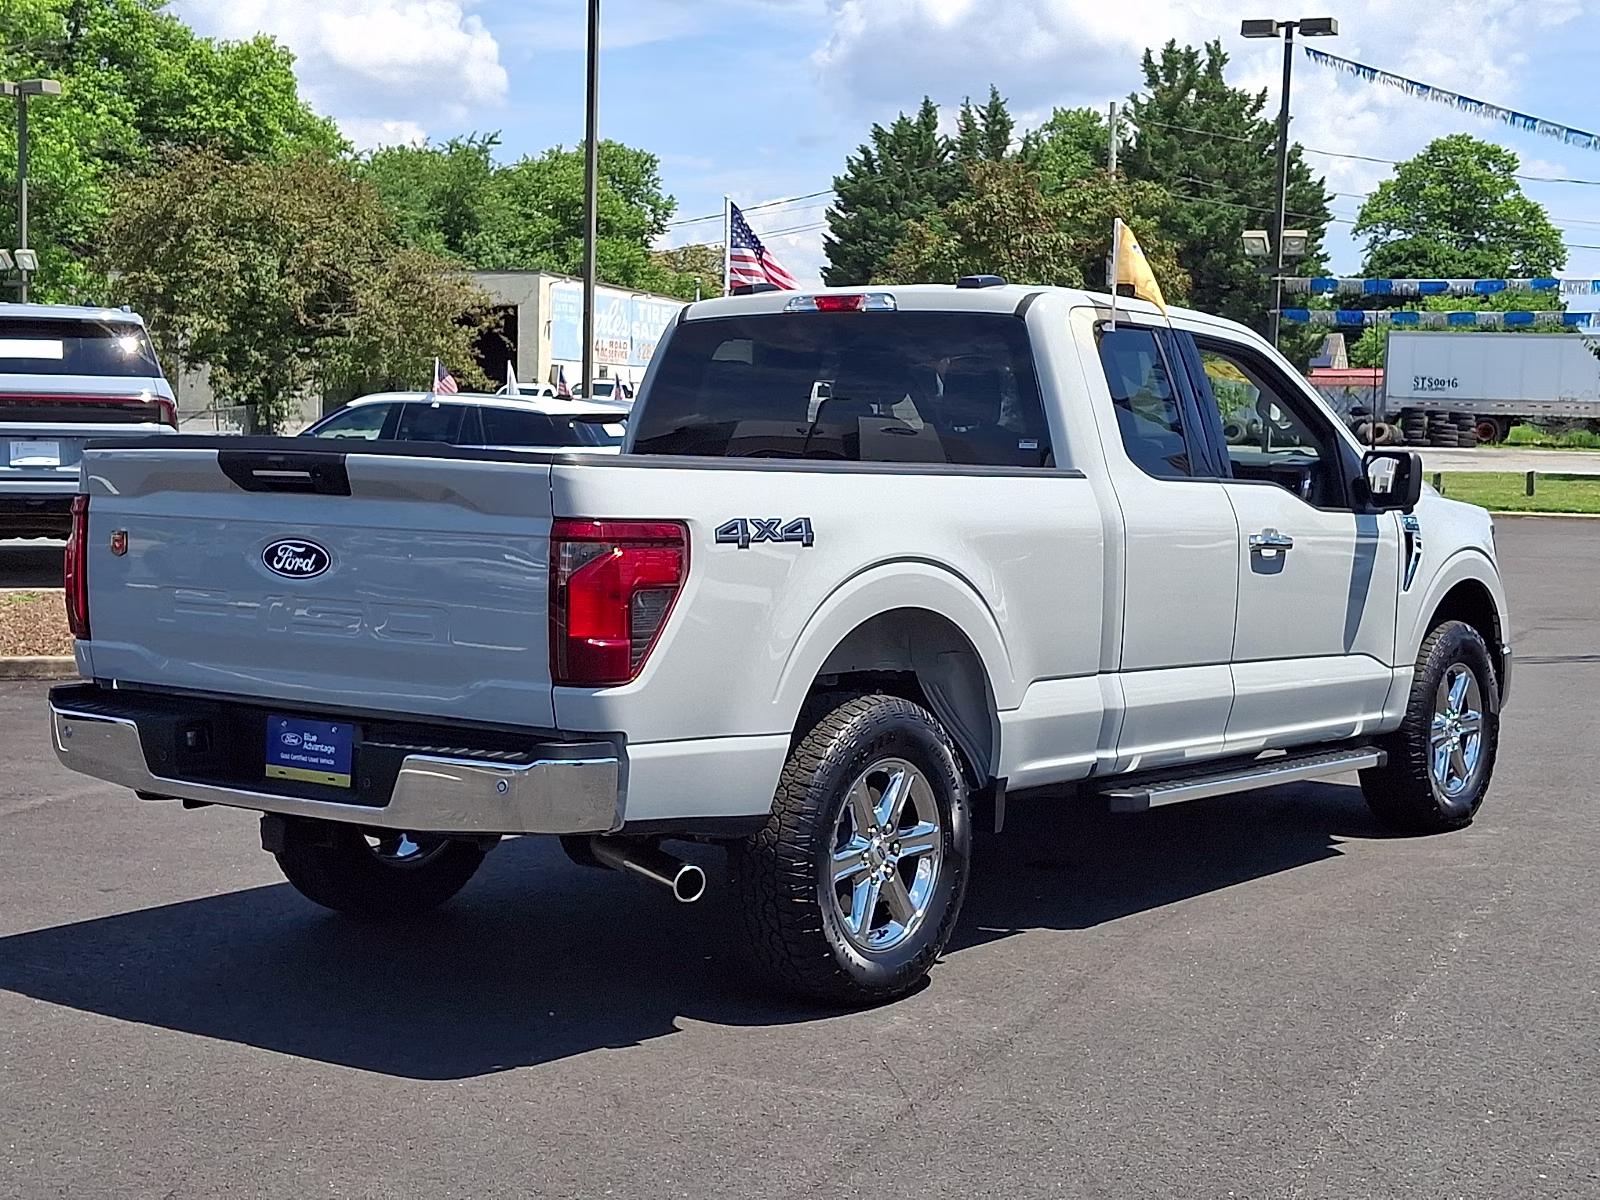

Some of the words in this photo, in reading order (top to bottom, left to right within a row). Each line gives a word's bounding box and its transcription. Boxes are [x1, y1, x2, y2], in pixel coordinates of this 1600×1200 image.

[638, 303, 671, 325] TIRE
[609, 340, 628, 350] ROAD
[608, 349, 628, 360] SERVICE
[272, 544, 317, 572] Ford
[303, 732, 318, 742] Blue
[302, 741, 336, 755] Advantage
[290, 753, 308, 762] Certified
